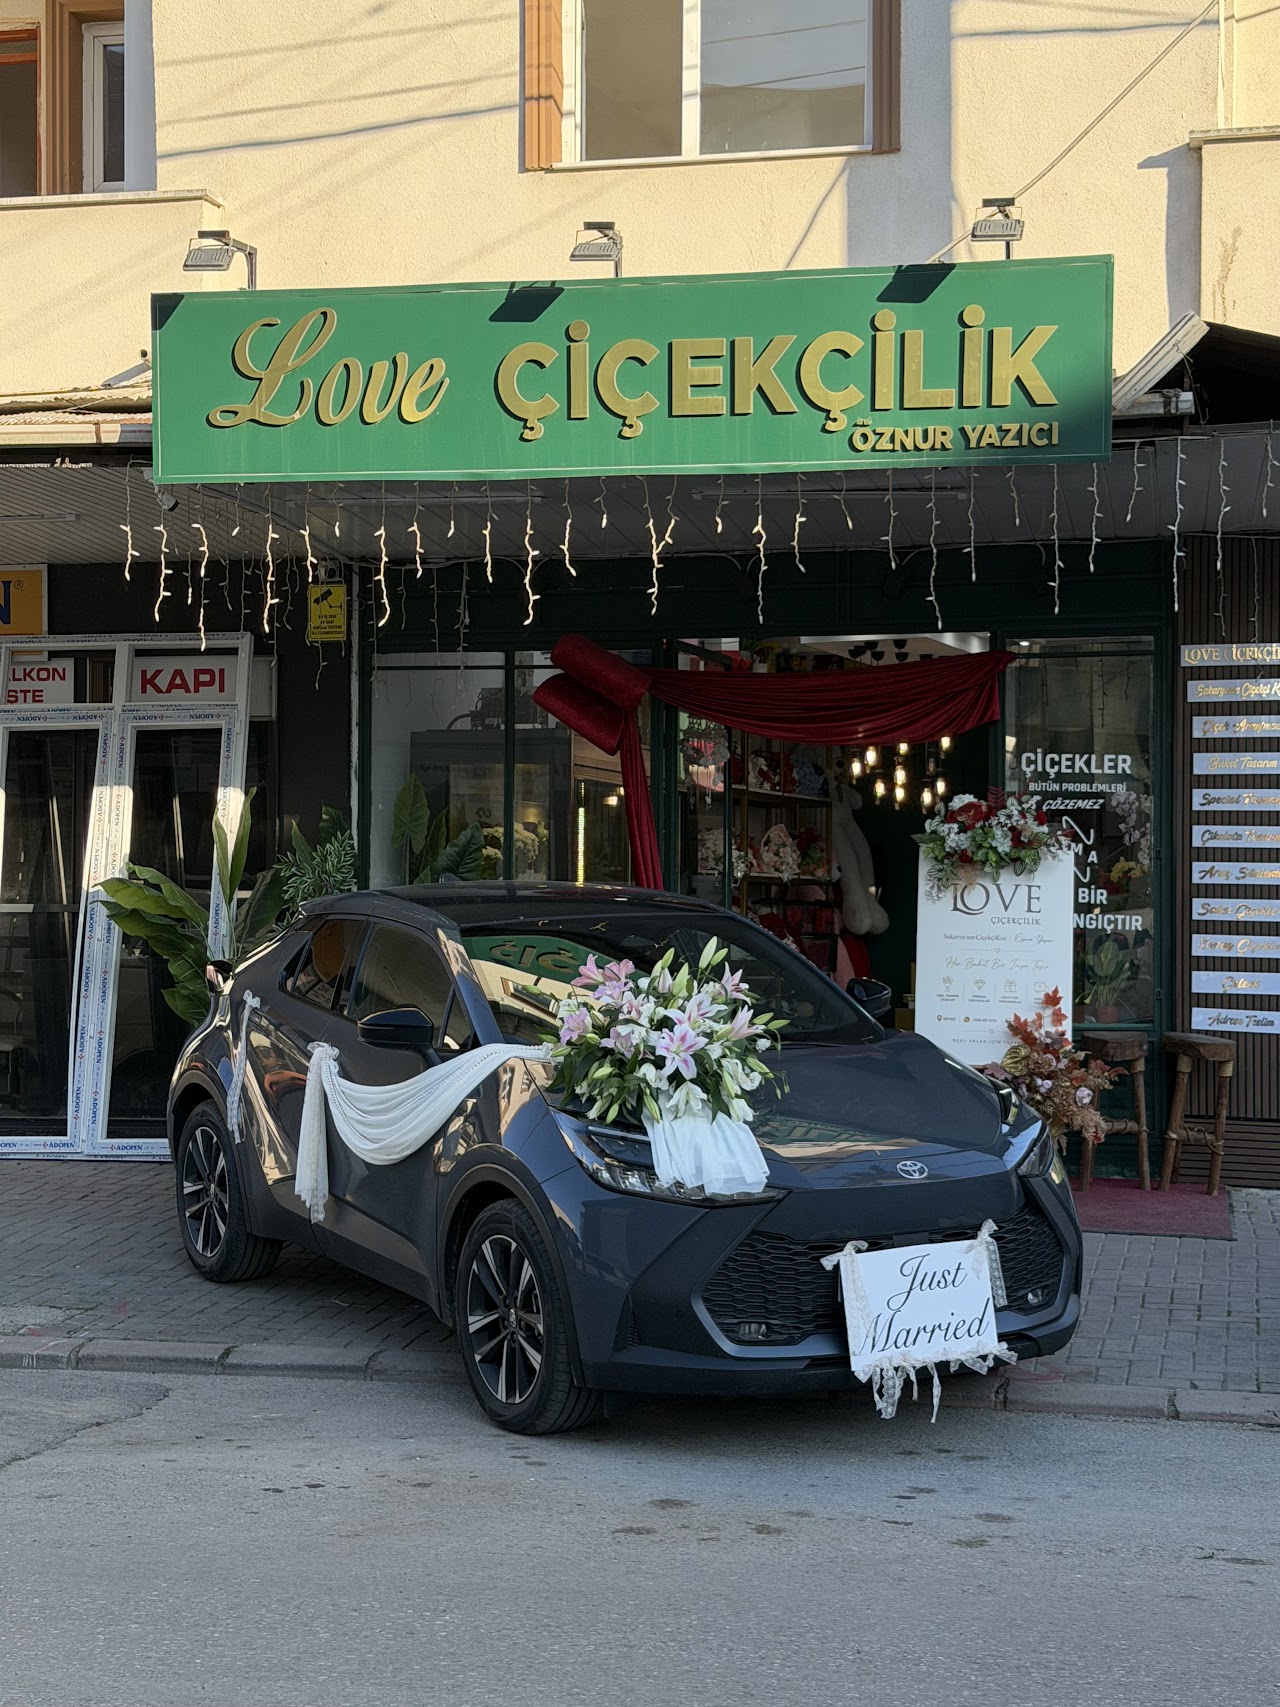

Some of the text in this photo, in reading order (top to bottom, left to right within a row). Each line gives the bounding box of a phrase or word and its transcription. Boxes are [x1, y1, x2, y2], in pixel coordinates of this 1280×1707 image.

[206, 304, 1060, 443] Love ÇİÇEKÇİLİK
[848, 417, 1060, 453] ÖZNUR YAZICI
[1184, 648, 1221, 665] LOVE
[9, 667, 66, 682] LKON
[140, 667, 226, 694] KAPI
[1021, 748, 1133, 779] ÇİÇEKLER
[1028, 780, 1127, 793] BÜTÜN PROBLEMLERİ
[950, 882, 1042, 916] LOVE
[1078, 884, 1108, 905] BİR
[886, 1253, 968, 1312] Just
[860, 1297, 991, 1355] Married
